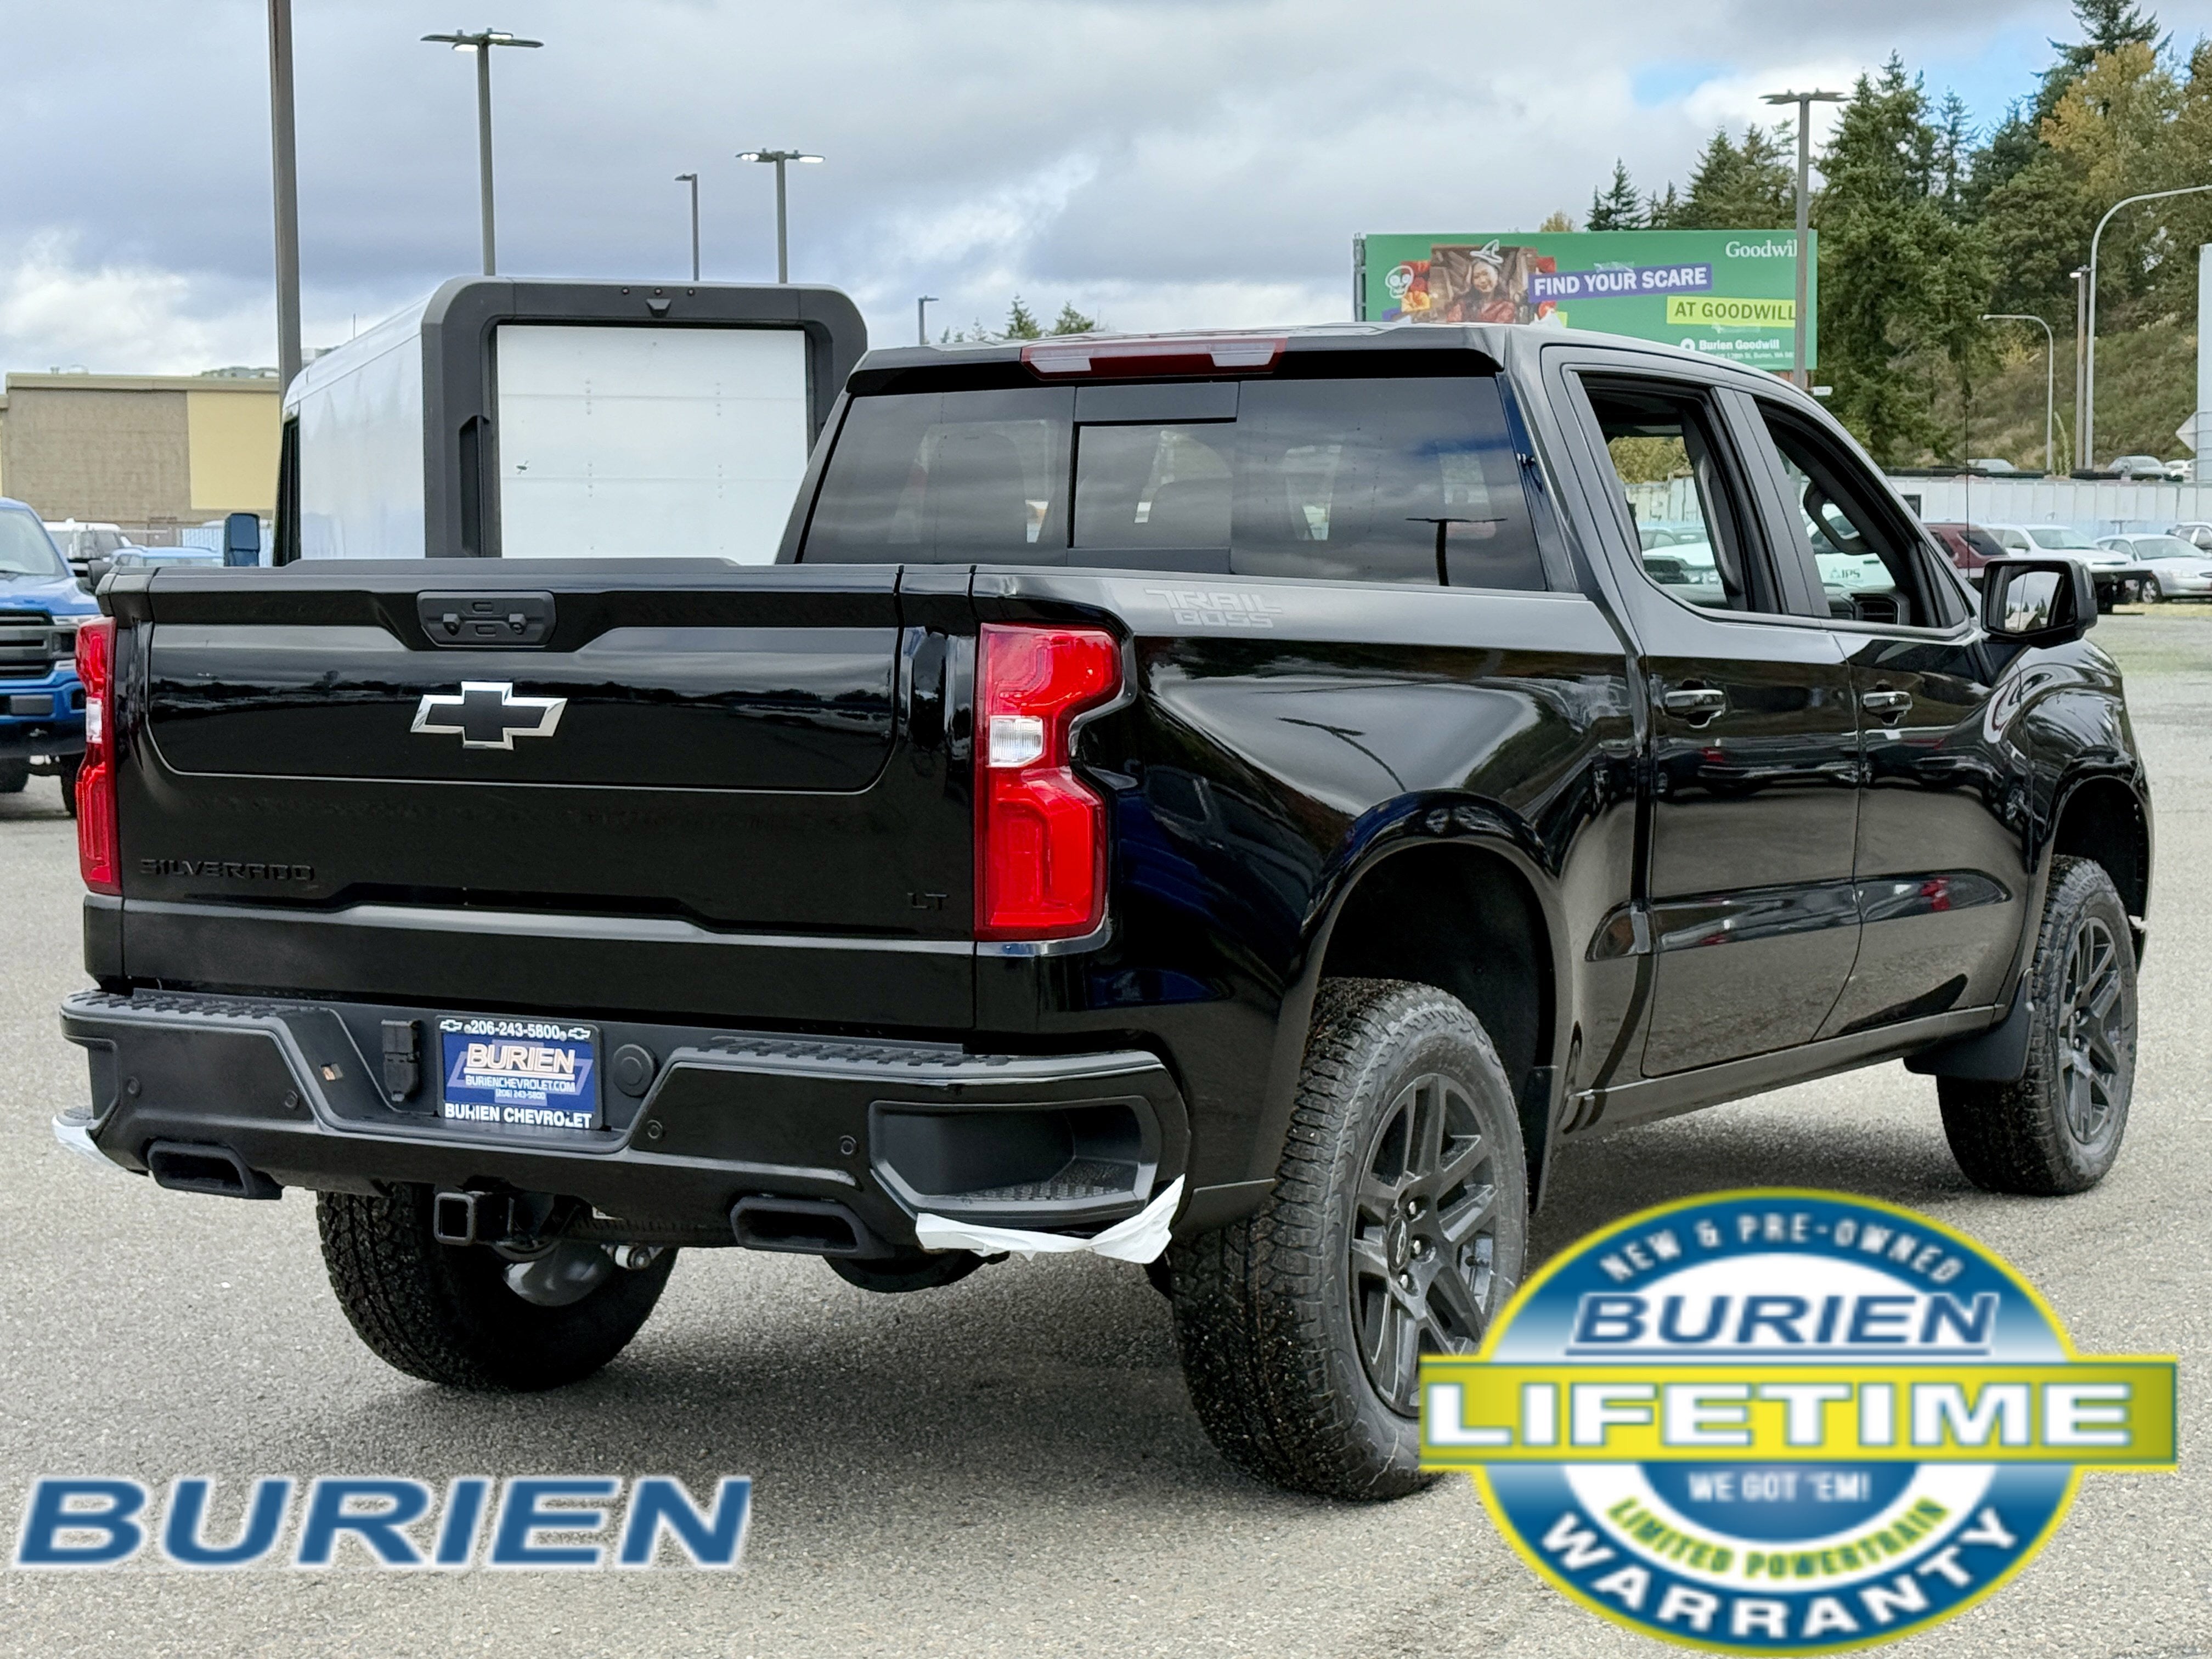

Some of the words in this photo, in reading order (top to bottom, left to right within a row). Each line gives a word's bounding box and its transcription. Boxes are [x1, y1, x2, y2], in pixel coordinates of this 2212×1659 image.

[1725, 239, 1798, 258] Goodwil
[1534, 276, 1580, 296] FIND
[1584, 272, 1637, 292] YOUR
[1642, 267, 1707, 289] SCARE
[1674, 302, 1696, 317] AT
[1702, 302, 1796, 320] GOODWILL
[1699, 340, 1733, 350] Burien
[1735, 338, 1780, 349] Goodwill
[1144, 588, 1283, 614] TRAIL
[1172, 609, 1274, 628] BOSS
[140, 859, 314, 880] SILVERADO
[907, 892, 949, 910] LT
[470, 1019, 560, 1039] 206-243-5800
[466, 1043, 576, 1074] BURIEN
[465, 1075, 575, 1093] BURIENCHEVROLET.COM
[445, 1102, 500, 1121] BURIEN
[503, 1107, 592, 1128] CHEVROLET
